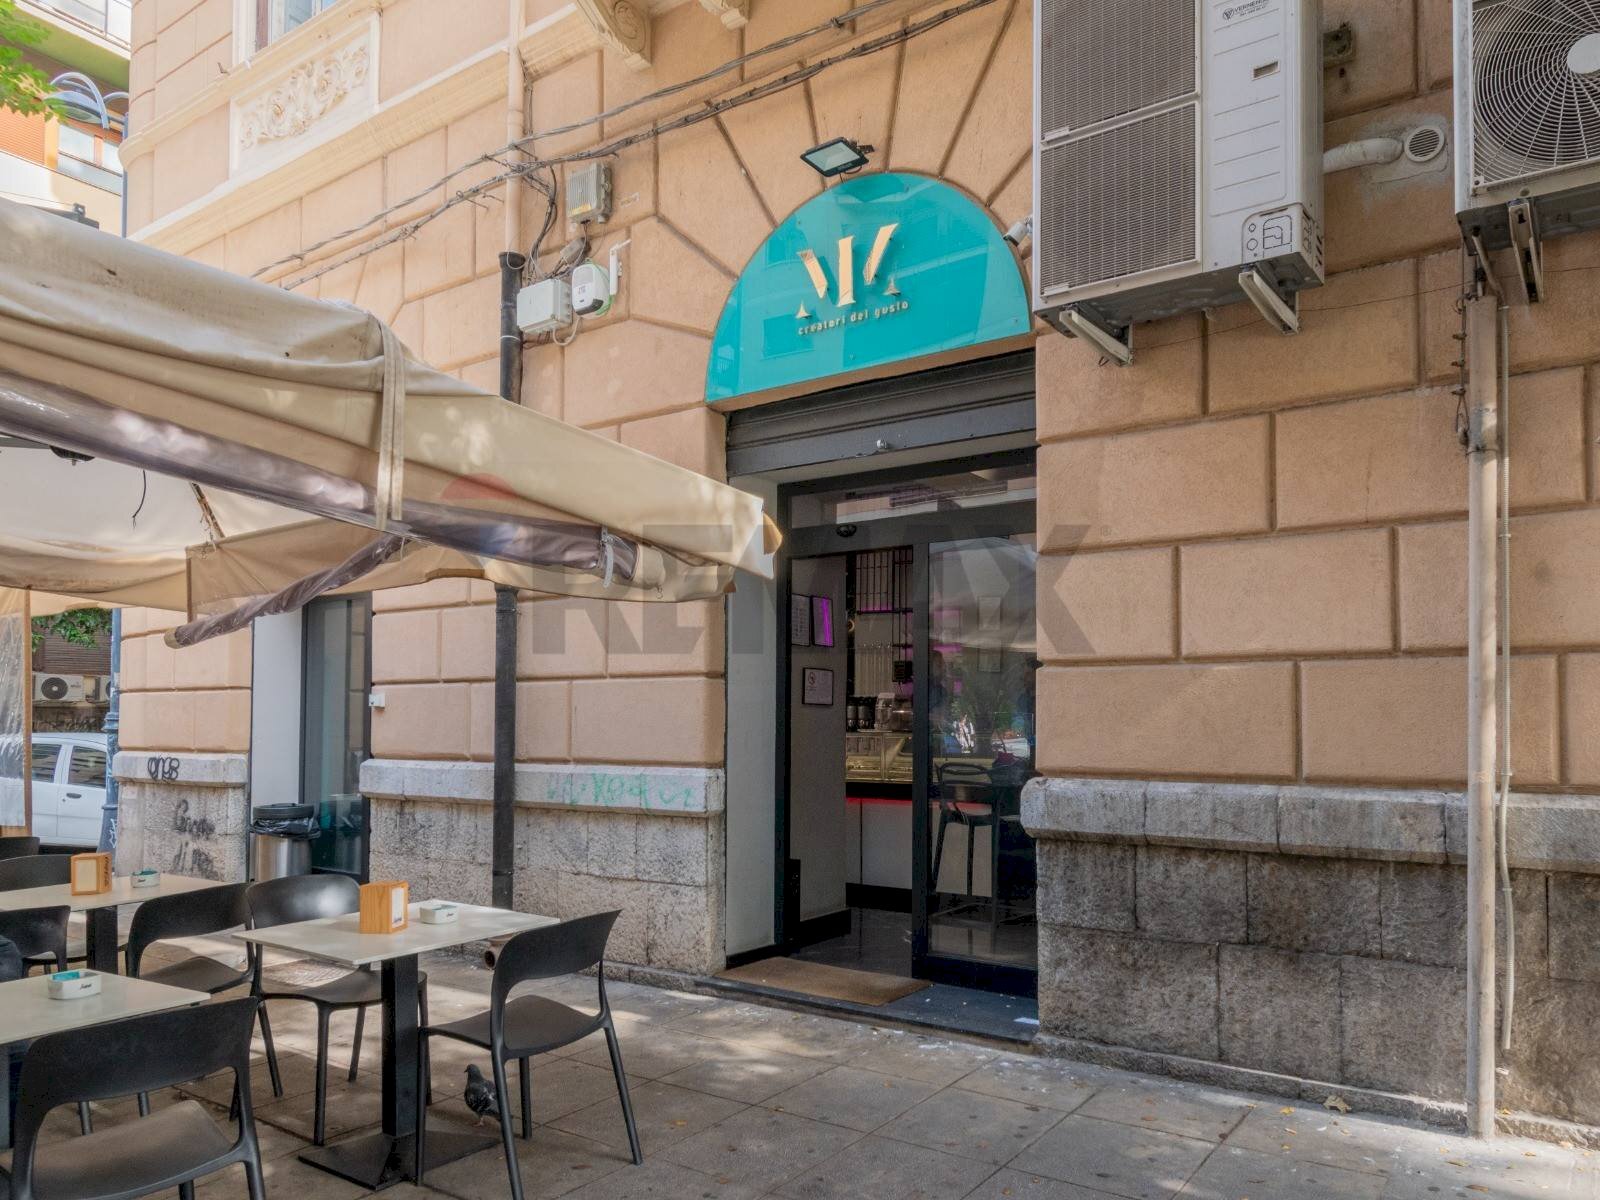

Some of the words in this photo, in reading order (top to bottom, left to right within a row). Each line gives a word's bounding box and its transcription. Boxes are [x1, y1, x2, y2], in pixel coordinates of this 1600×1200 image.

[797, 315, 846, 336] creatori
[850, 309, 869, 323] del
[874, 300, 910, 319] gusto
